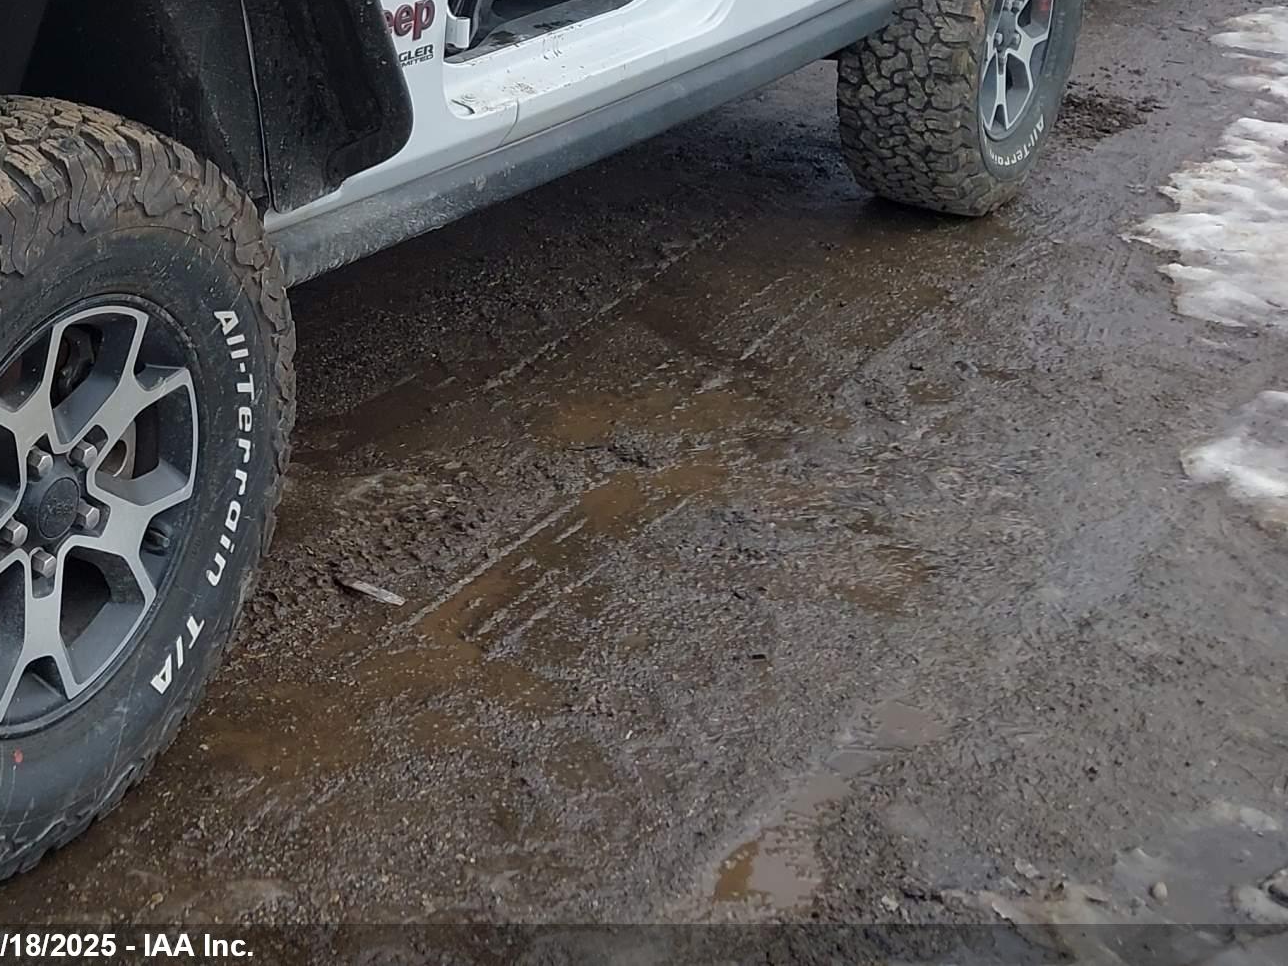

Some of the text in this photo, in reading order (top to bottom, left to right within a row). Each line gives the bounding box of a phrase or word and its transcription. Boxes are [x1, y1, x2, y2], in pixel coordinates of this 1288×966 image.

[398, 43, 434, 63] GLER
[401, 54, 434, 69] MITED
[149, 309, 257, 695] All-Terrain T/A
